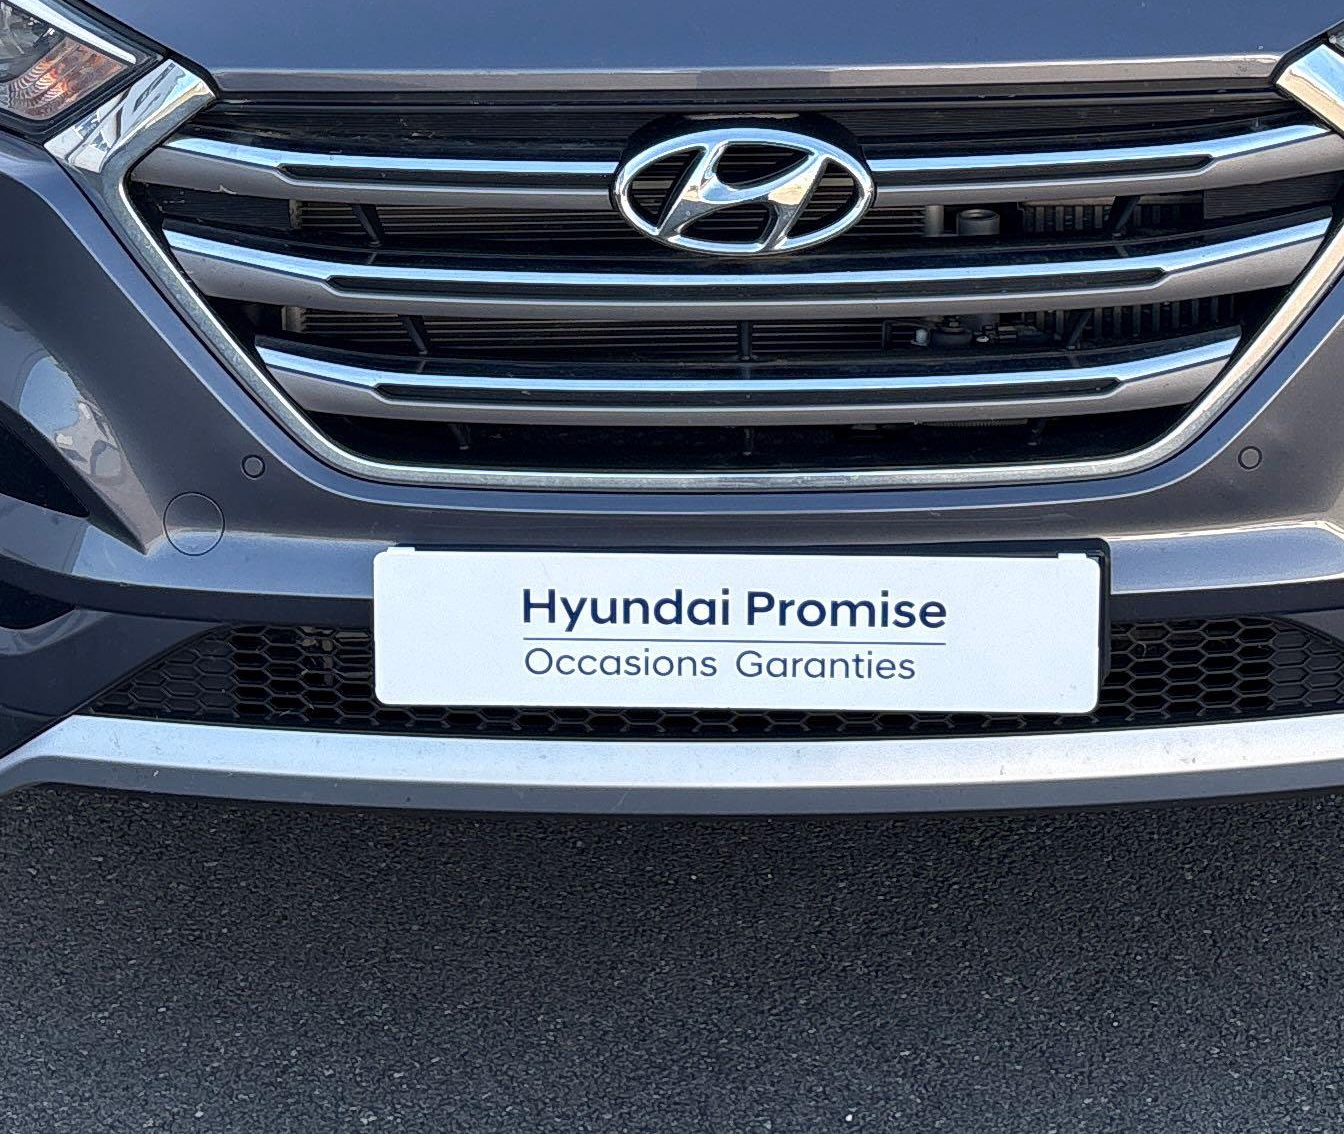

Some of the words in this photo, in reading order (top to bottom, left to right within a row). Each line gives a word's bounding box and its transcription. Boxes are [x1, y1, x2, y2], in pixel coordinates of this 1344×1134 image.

[523, 588, 729, 632] Hyundai
[748, 590, 946, 628] Promise
[525, 648, 717, 676] Occasions
[736, 650, 915, 679] Garanties
